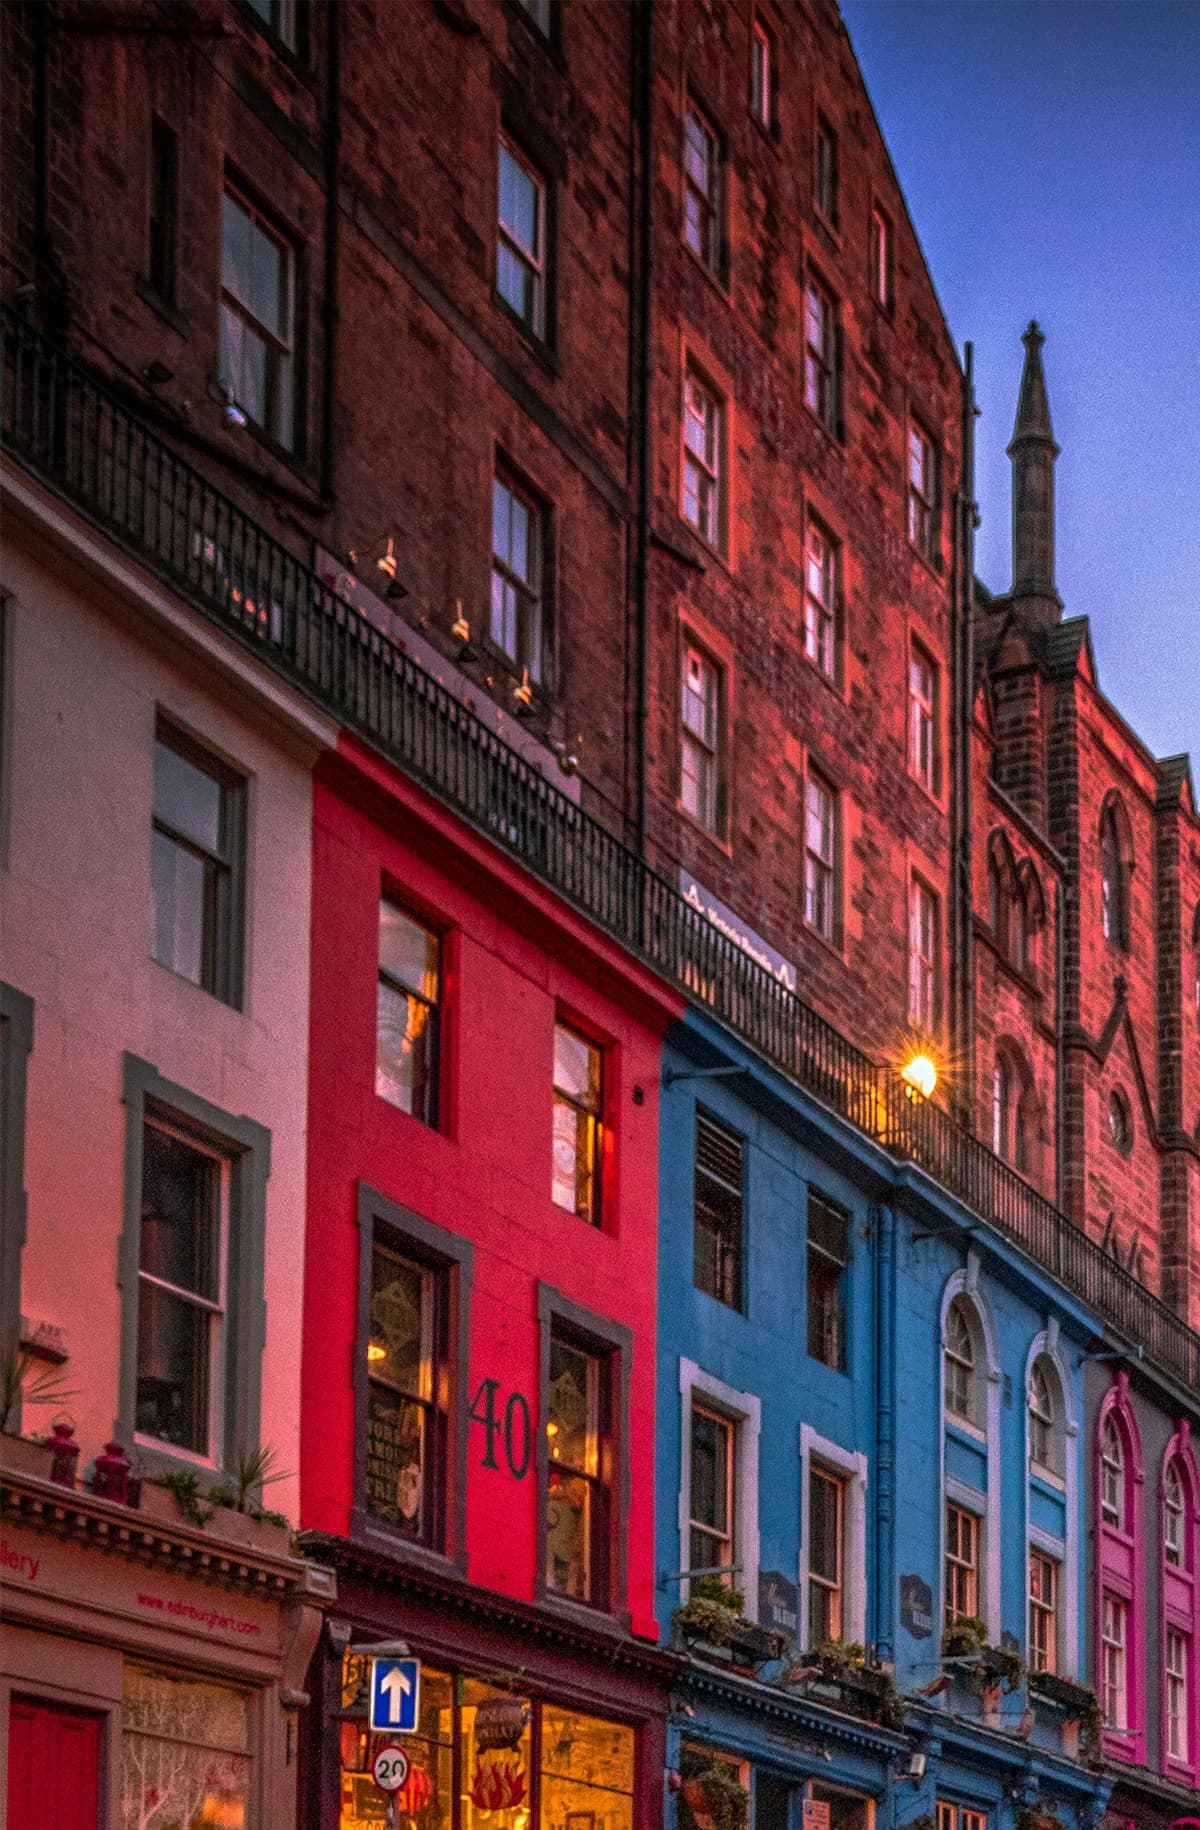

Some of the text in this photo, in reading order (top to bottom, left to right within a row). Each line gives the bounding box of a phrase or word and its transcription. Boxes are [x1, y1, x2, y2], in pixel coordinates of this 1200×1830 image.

[468, 1377, 531, 1480] 40
[136, 1592, 262, 1637] www.edinburghart.com
[378, 1759, 405, 1783] 20
